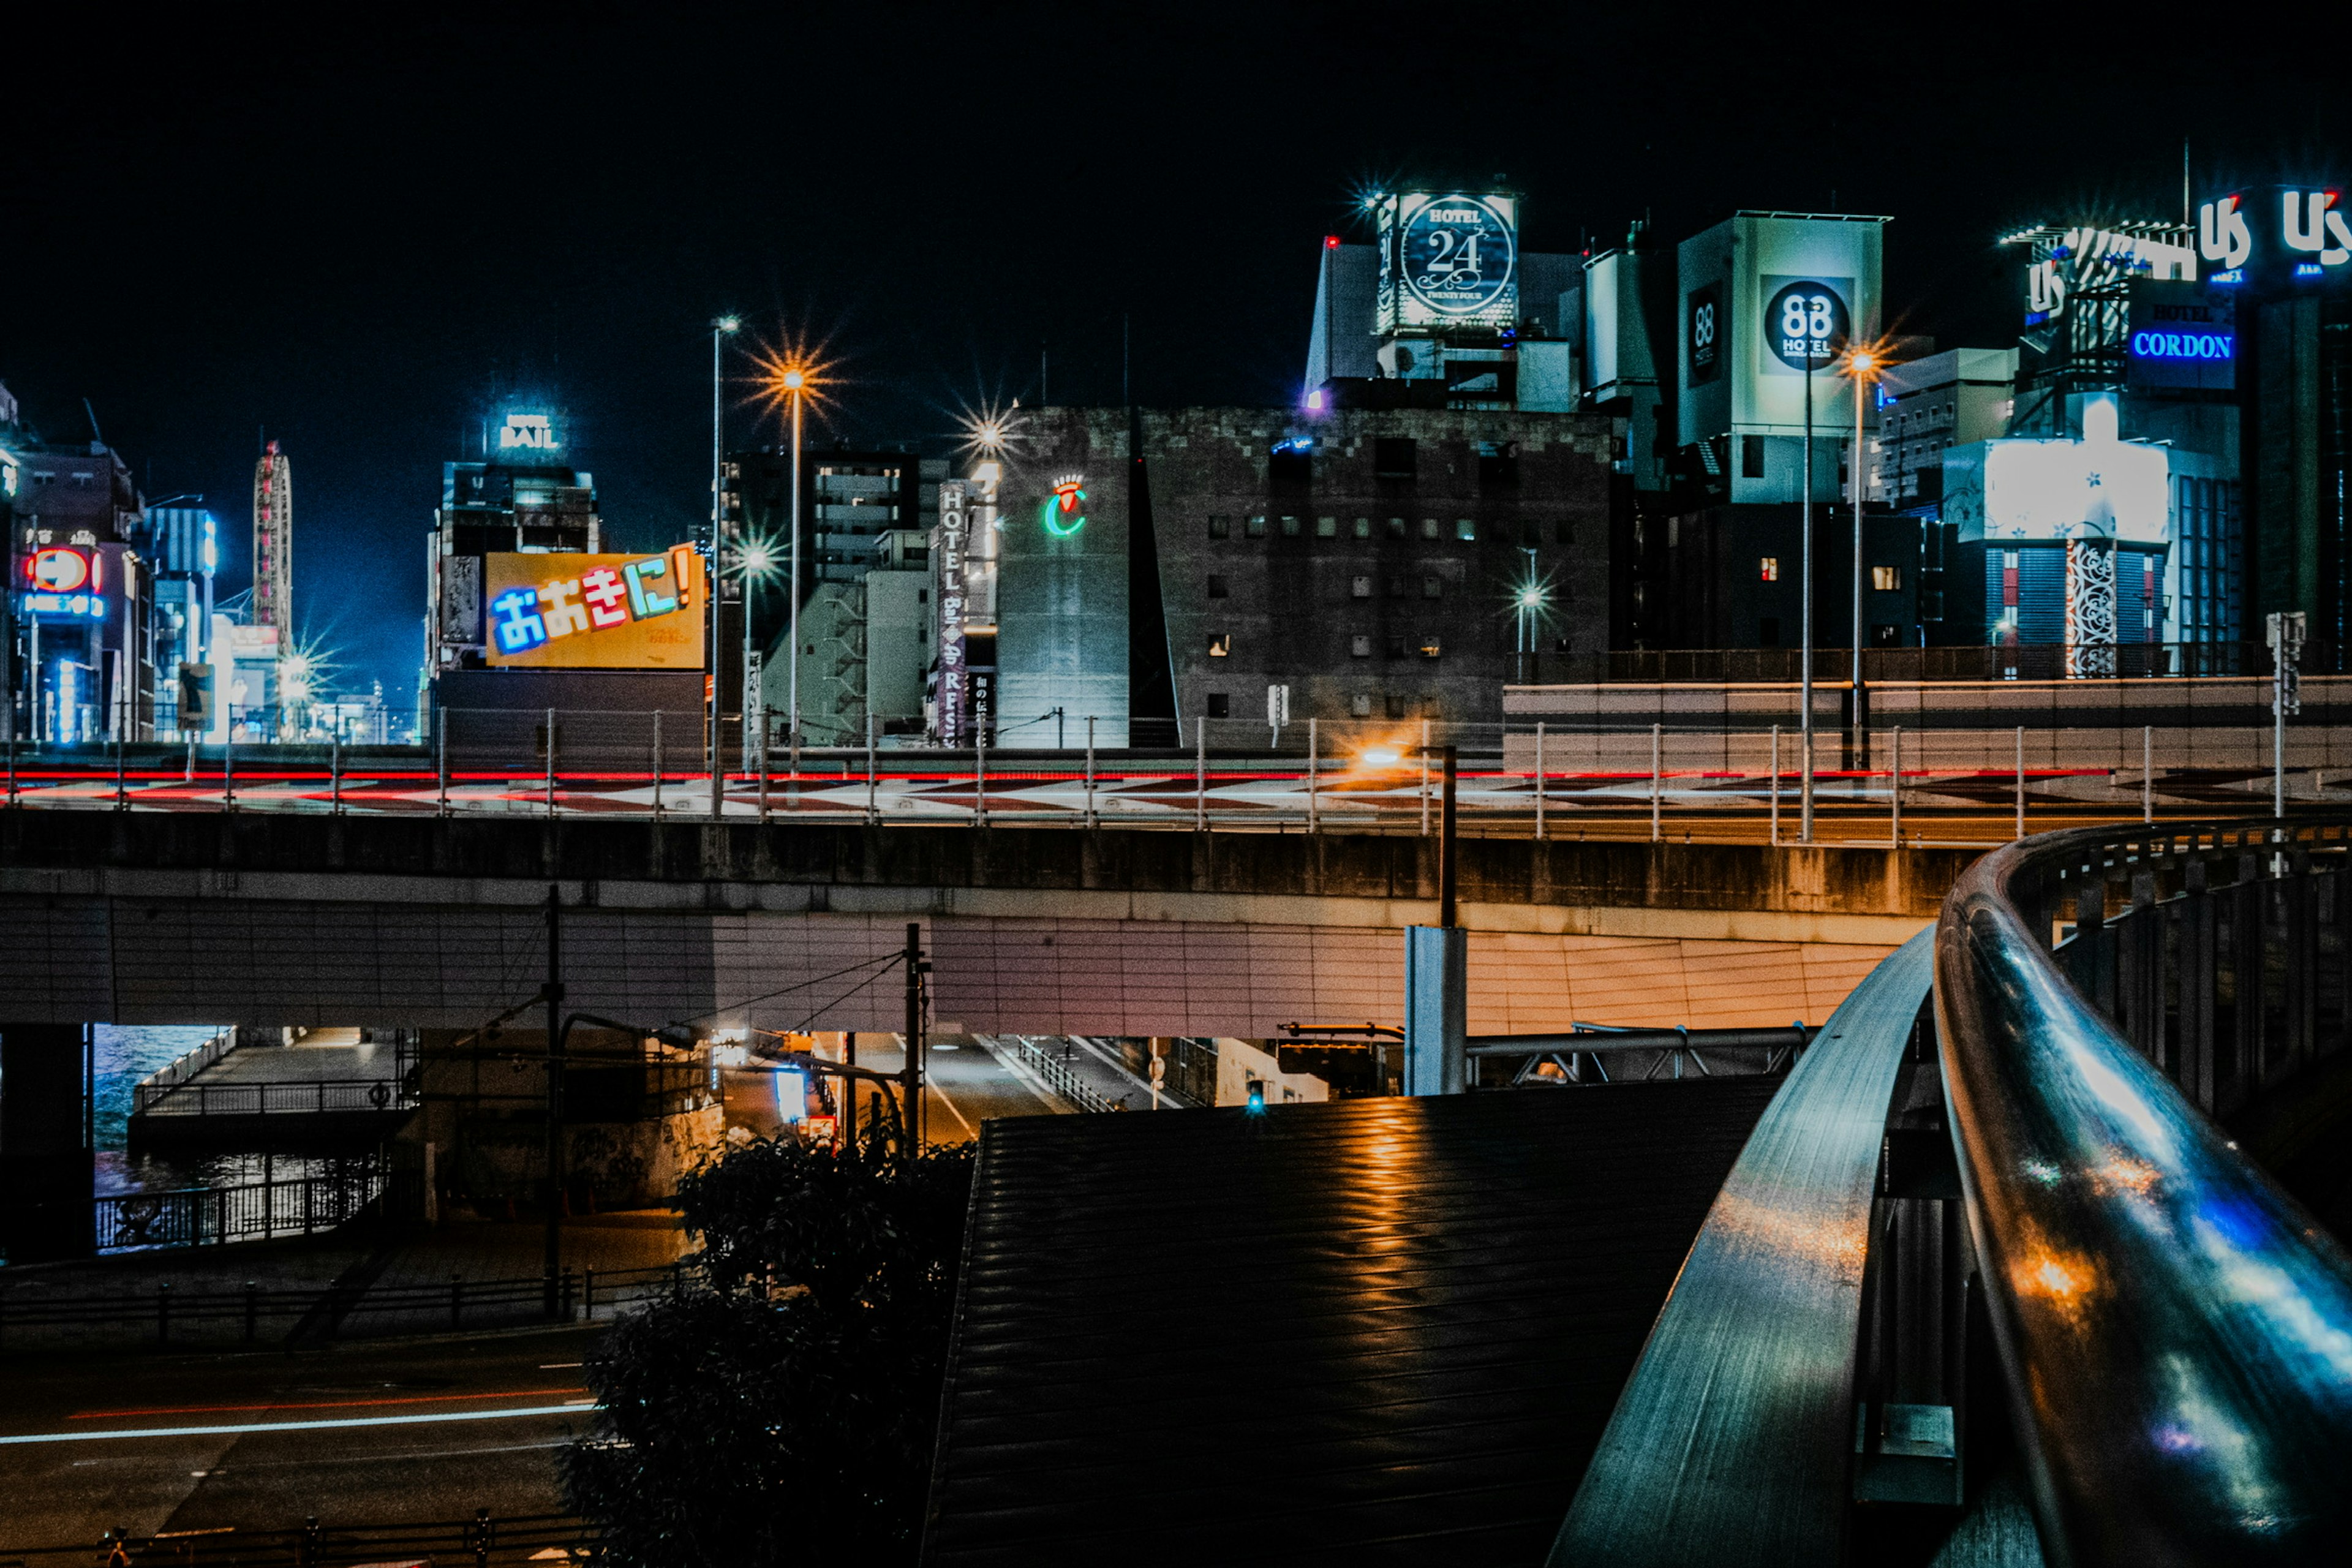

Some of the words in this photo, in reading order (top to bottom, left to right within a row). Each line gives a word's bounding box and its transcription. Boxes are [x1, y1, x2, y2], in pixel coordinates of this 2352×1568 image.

[1429, 209, 1482, 224] HOTEL
[1427, 229, 1483, 273] 24
[1695, 303, 1714, 347] 88
[1782, 295, 1833, 339] 88
[2154, 305, 2213, 322] HOTEL
[1783, 339, 1831, 352] HOEL
[2134, 333, 2232, 358] CORDON
[944, 492, 961, 590] HOTEL
